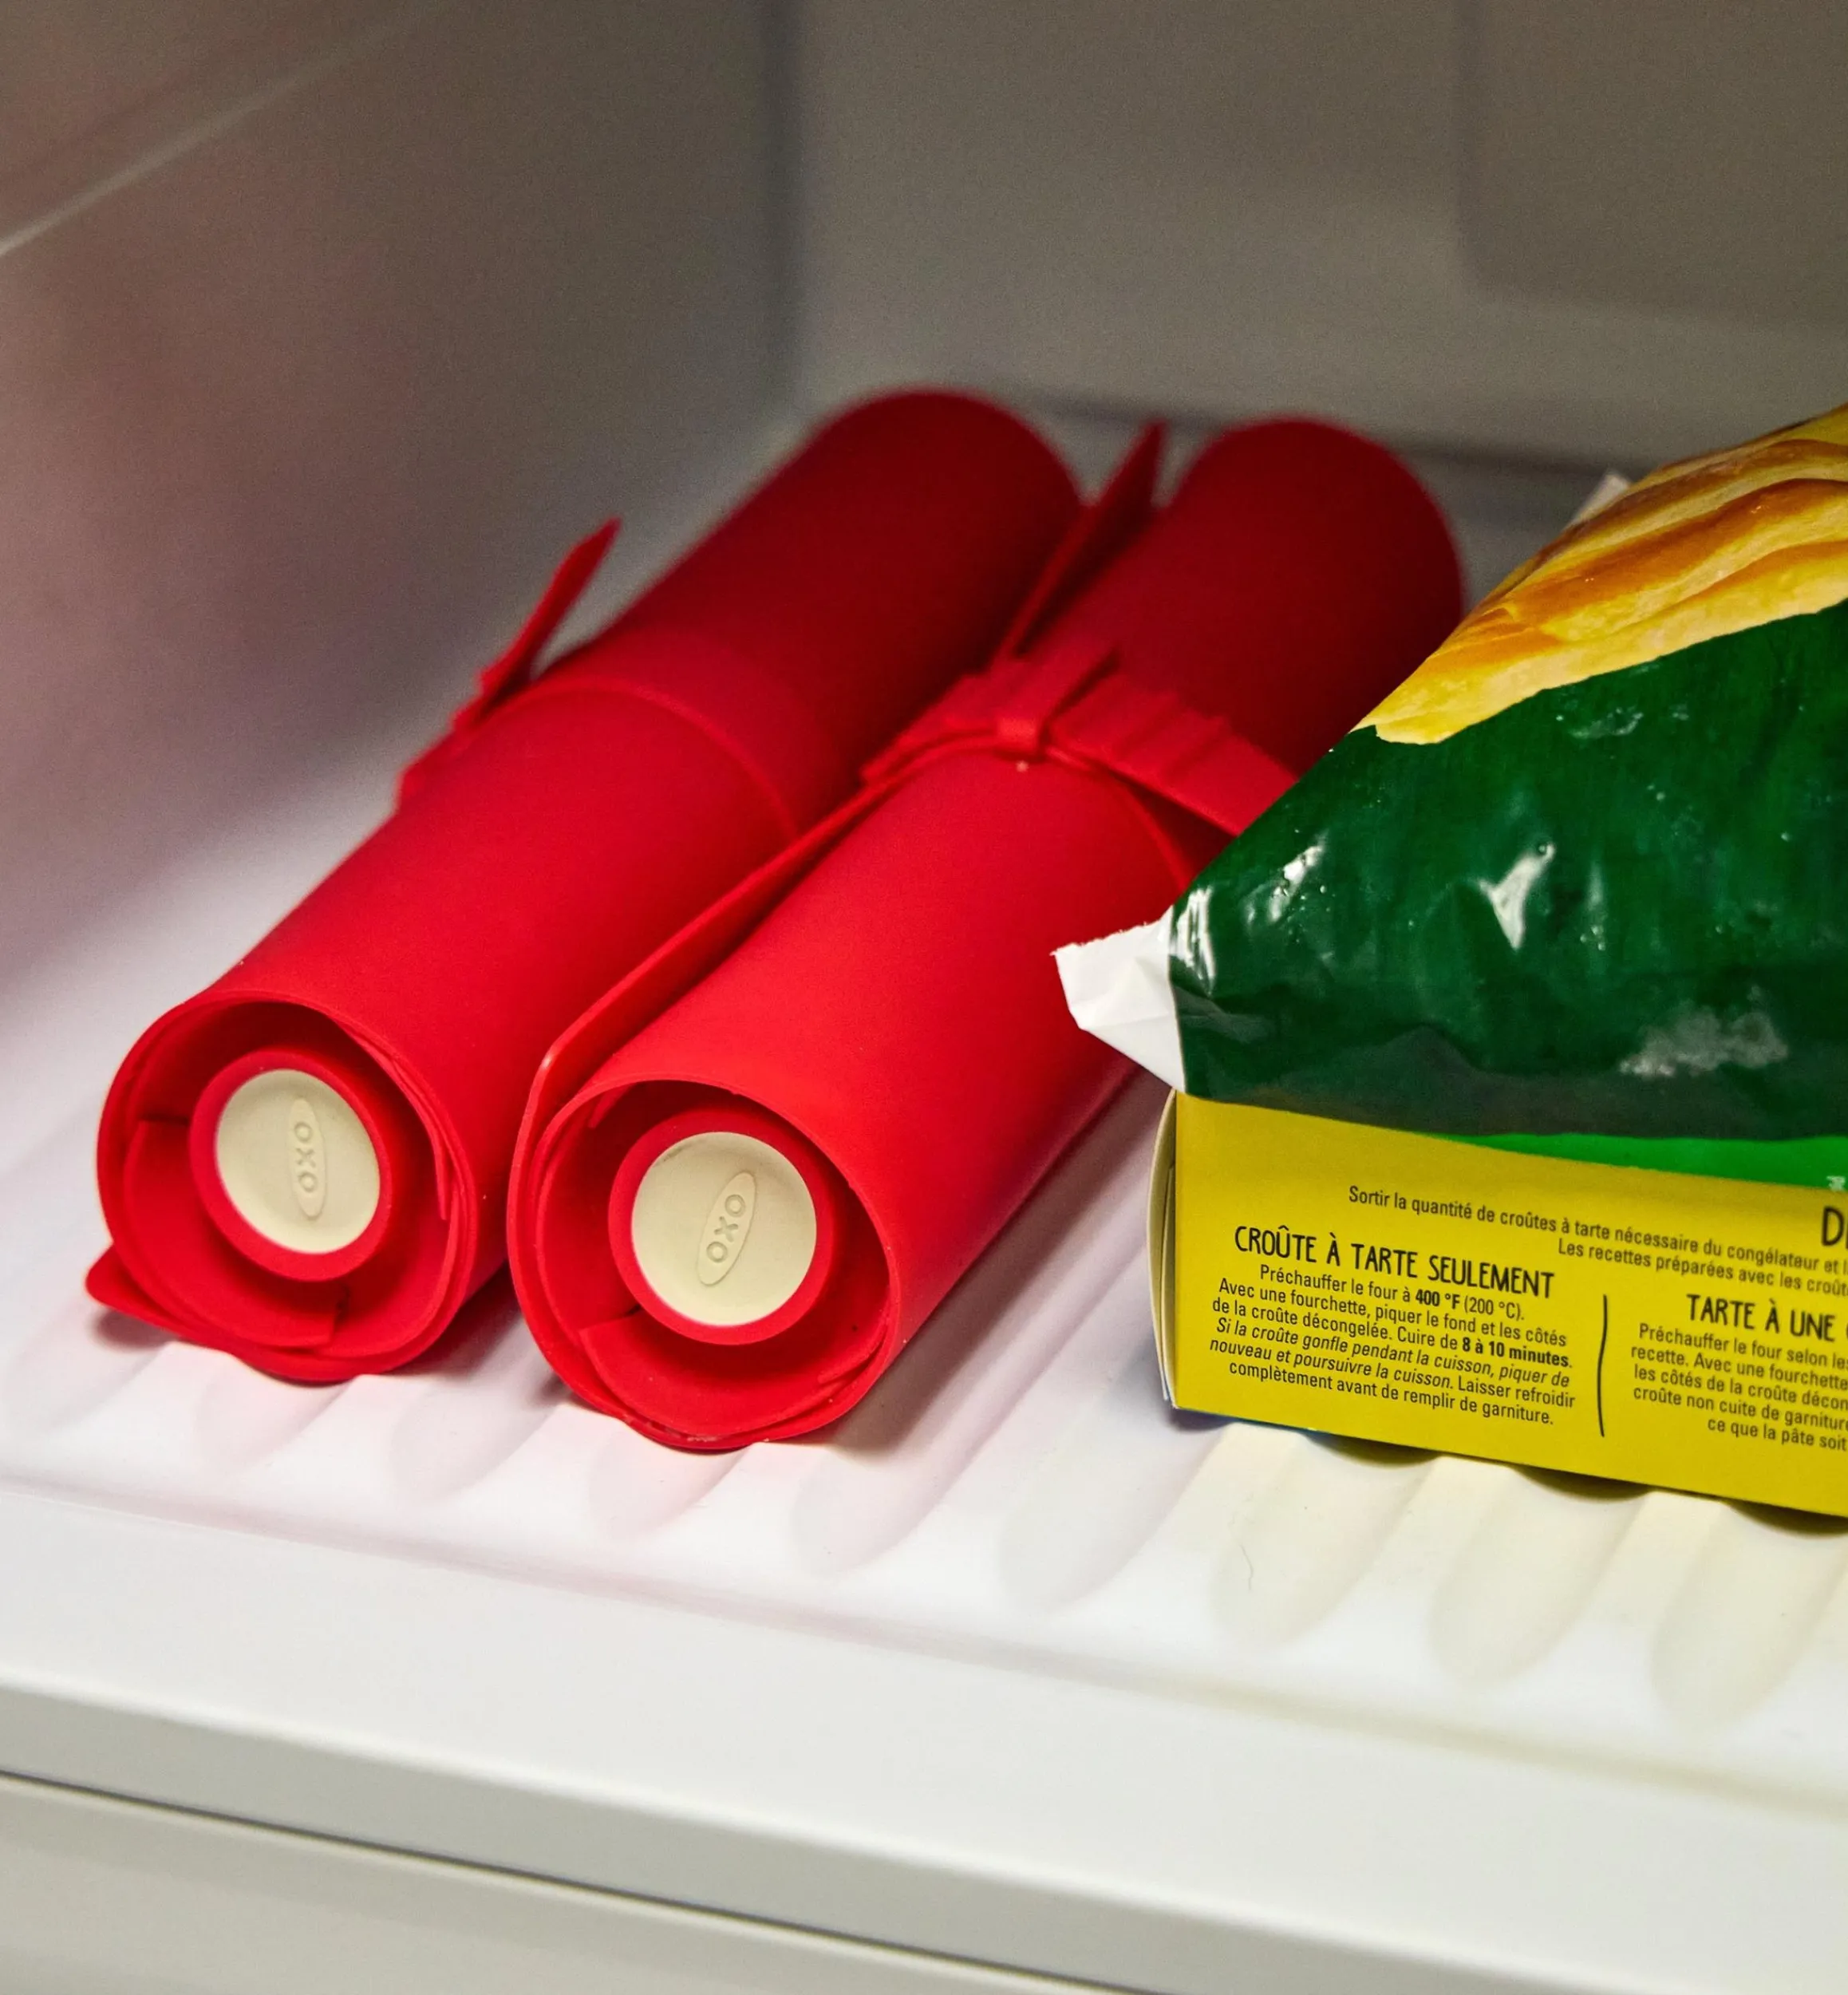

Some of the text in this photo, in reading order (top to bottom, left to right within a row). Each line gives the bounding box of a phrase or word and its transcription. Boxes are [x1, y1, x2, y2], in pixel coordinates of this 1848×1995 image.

[294, 1121, 319, 1193] OXO
[706, 1194, 746, 1263] OXO
[1349, 1185, 1390, 1207] Sortir
[1395, 1192, 1407, 1210] la
[1412, 1199, 1472, 1219] quantité
[1477, 1205, 1495, 1223] de
[1500, 1211, 1556, 1232] croûtes
[1562, 1218, 1570, 1234] à
[1575, 1221, 1610, 1239] tarte
[1615, 1227, 1699, 1252] nécessaire
[1704, 1239, 1721, 1256] du
[1728, 1246, 1819, 1270] congélateur
[1824, 1259, 1838, 1274] et
[1235, 1225, 1554, 1298] CROÛTE À TARTE SEULEMENT
[1261, 1264, 1347, 1292] Préchauffer
[1352, 1278, 1363, 1295] le
[1368, 1281, 1398, 1300] four
[1403, 1286, 1410, 1302] à
[1416, 1289, 1440, 1306] 400
[1464, 1296, 1494, 1315] (200
[1558, 1238, 1848, 1296] Les recettes préparées avec les croût
[1213, 1297, 1572, 1368] de la croûte décongelée. Cuire de 8 à 10 minutes.
[1219, 1278, 1566, 1347] Avec une fourchette, piquer le fond et les côtés
[1687, 1294, 1755, 1329] TARTE
[1764, 1298, 1780, 1334] À
[1790, 1310, 1835, 1342] UNE
[1210, 1340, 1575, 1408] nouveau et poursuivre la cuisson. Laisser refroidir
[1217, 1317, 1570, 1388] Si la croûte gonfle pendant la cuisson, piquer de
[1632, 1347, 1688, 1365] recette.
[1694, 1353, 1731, 1373] Avec
[1737, 1364, 1764, 1377] une
[1640, 1323, 1729, 1351] Préchauffer
[1734, 1338, 1747, 1354] le
[1752, 1341, 1782, 1358] four
[1787, 1348, 1828, 1366] selon
[1230, 1362, 1553, 1424] complètement avant de remplir de garniture.
[1633, 1388, 1681, 1405] croûte
[1687, 1396, 1714, 1410] non
[1720, 1401, 1755, 1416] cuite
[1762, 1404, 1779, 1420] de
[1635, 1364, 1655, 1381] les
[1661, 1369, 1701, 1388] côtés
[1708, 1376, 1724, 1392] de
[1731, 1379, 1742, 1394] la
[1748, 1385, 1796, 1403] croûte
[1708, 1419, 1847, 1452] ce que la pâte soit
